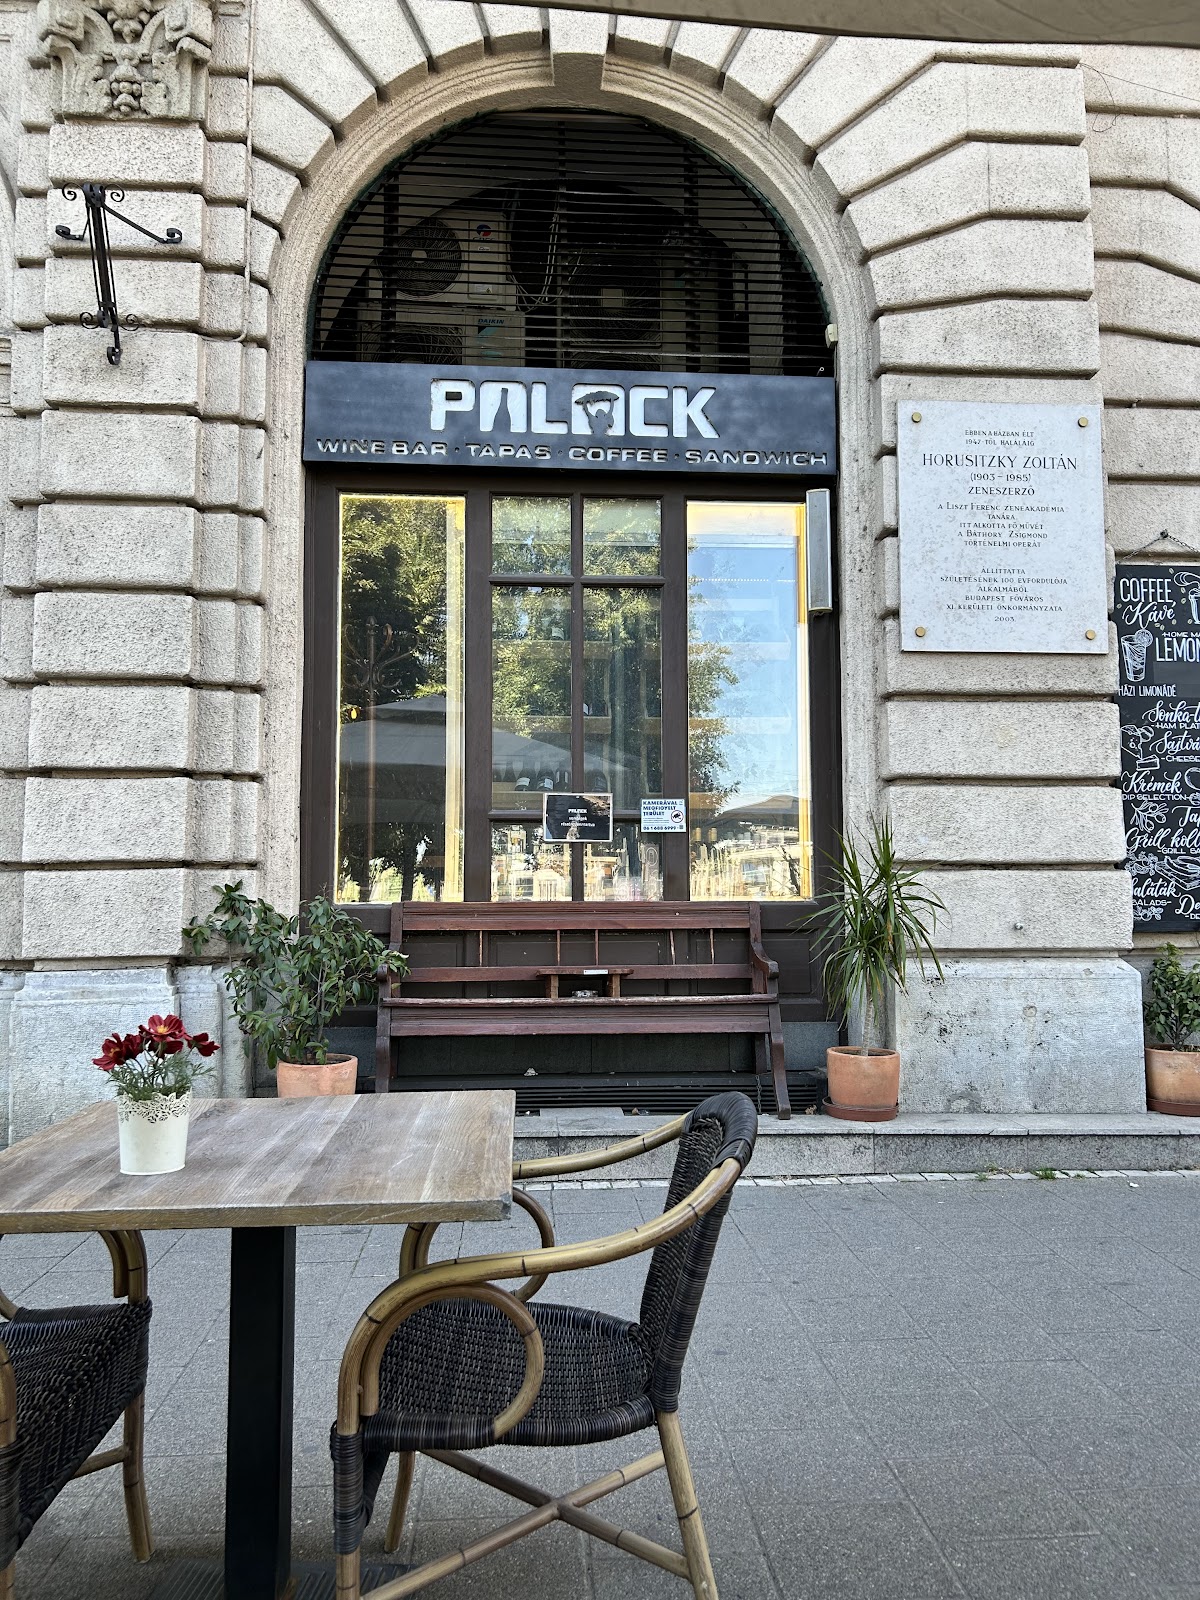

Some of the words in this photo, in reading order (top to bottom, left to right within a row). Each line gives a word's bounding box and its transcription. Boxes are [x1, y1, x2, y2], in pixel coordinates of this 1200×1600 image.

[993, 429, 1020, 437] HÁZBAN
[316, 438, 386, 455] WINE
[392, 441, 448, 456] BAR
[465, 442, 551, 460] TAPAS
[568, 447, 668, 463] COFFEE
[685, 449, 828, 466] SANDWICH
[923, 453, 1017, 468] HORUSITZKY
[1023, 454, 1077, 470] ZOLTÁN
[968, 485, 1035, 496] ZENESZERZŐ
[1120, 578, 1172, 603] COFFEE
[1121, 601, 1176, 630] Kávé
[1119, 684, 1136, 697] HÁZI
[1121, 770, 1183, 793] Krémek
[1126, 827, 1171, 852] Grill
